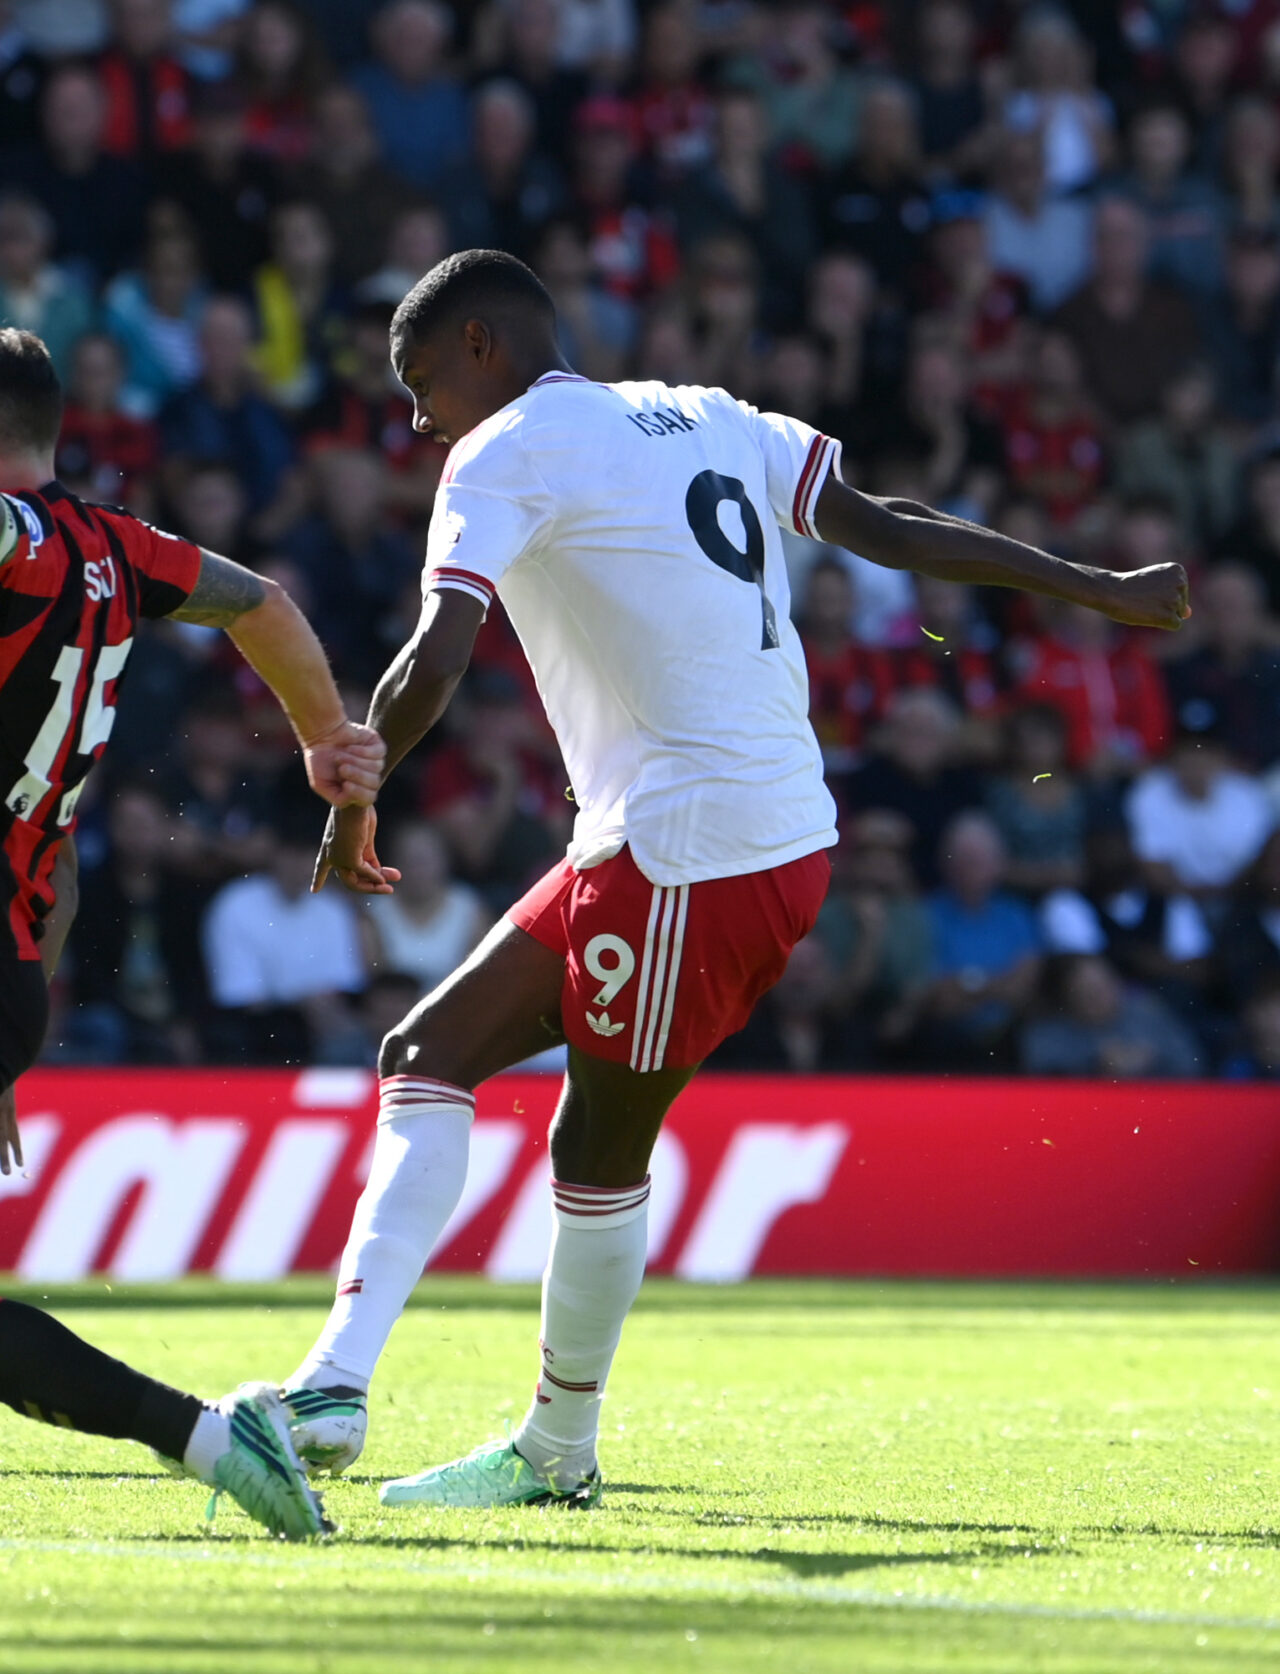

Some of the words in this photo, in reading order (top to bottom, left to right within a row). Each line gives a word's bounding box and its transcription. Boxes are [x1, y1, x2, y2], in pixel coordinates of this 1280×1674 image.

[626, 408, 699, 437] ISAK
[685, 469, 780, 651] 9
[5, 636, 133, 827] 15
[583, 933, 636, 1007] 9
